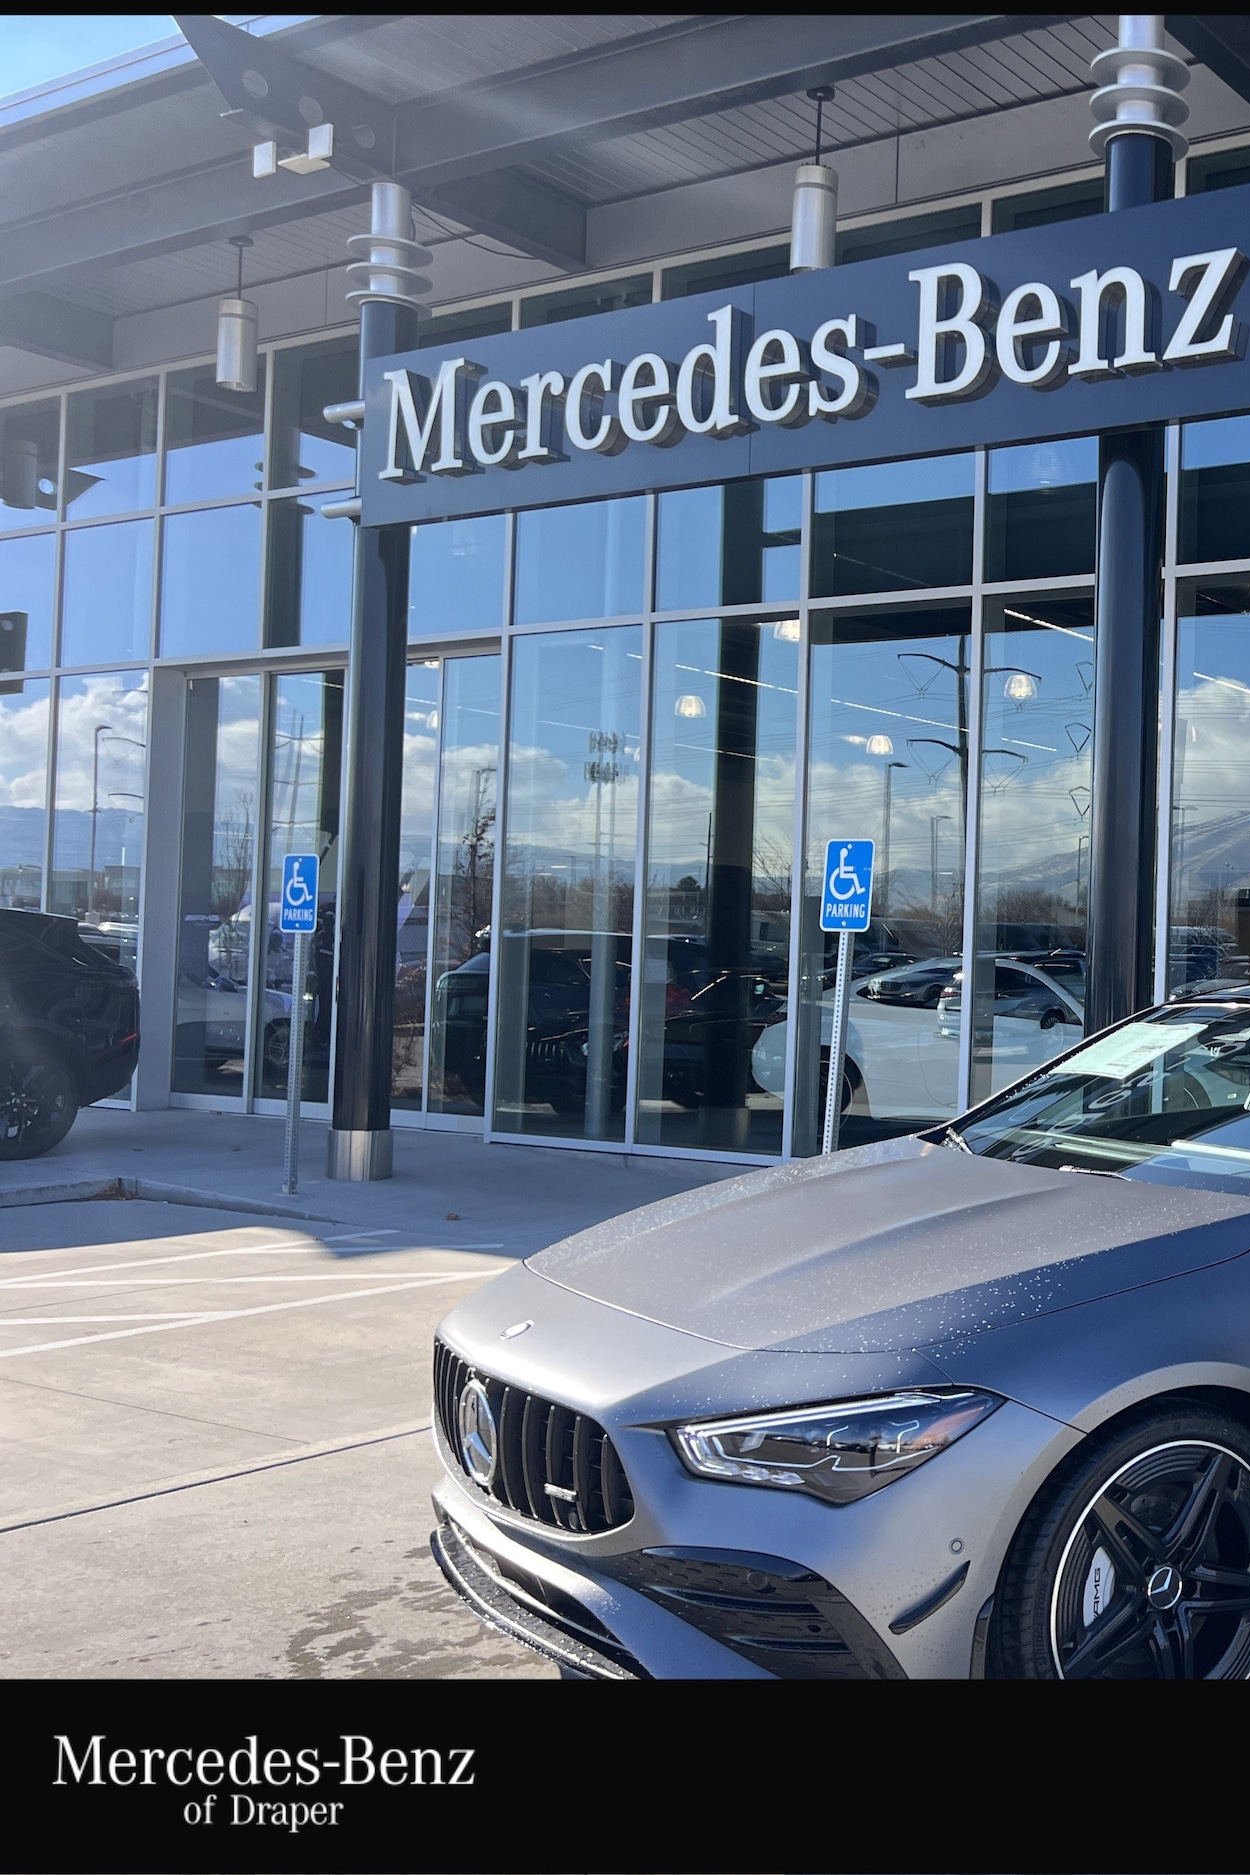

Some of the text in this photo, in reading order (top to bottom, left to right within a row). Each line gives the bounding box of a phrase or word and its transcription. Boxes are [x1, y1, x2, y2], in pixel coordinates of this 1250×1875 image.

[380, 247, 1239, 480] Mercedes-Benz
[284, 908, 314, 921] PARKING
[826, 903, 866, 918] PARKING
